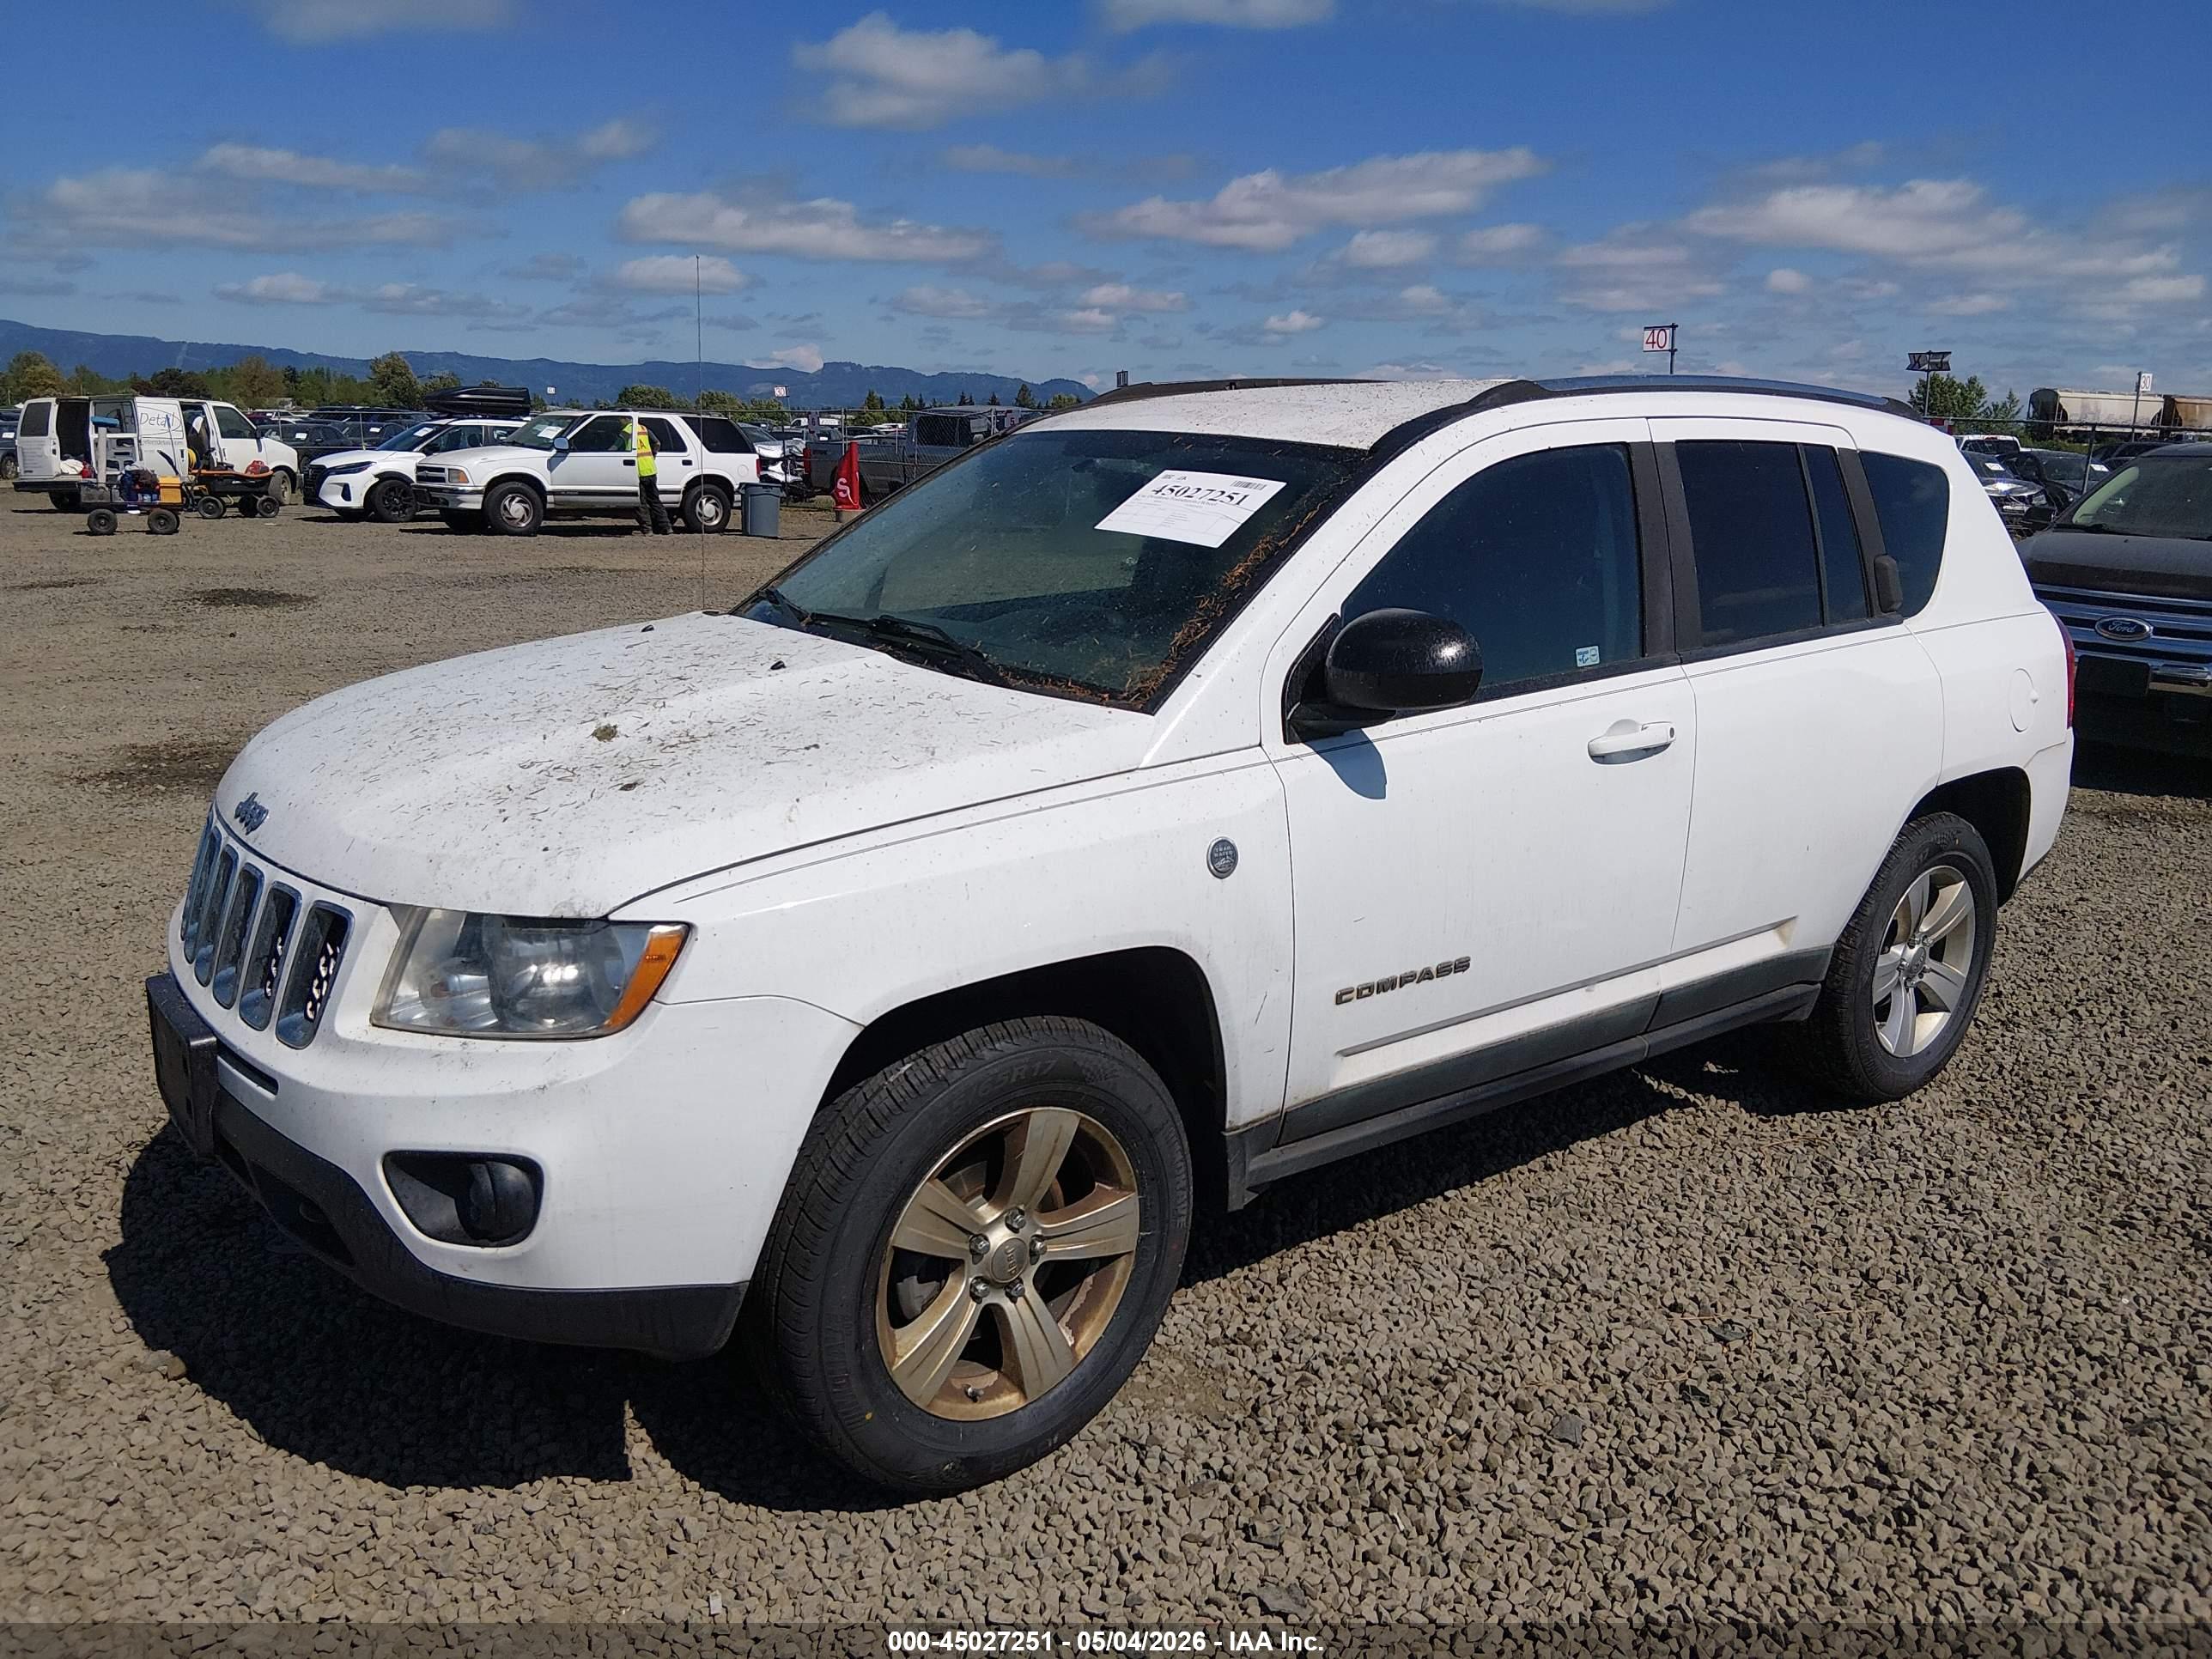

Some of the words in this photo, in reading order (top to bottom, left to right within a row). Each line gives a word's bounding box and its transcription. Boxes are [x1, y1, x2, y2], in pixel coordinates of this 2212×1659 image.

[1645, 329, 1668, 349] 40
[2140, 374, 2151, 390] 30
[140, 412, 175, 428] Detal
[1152, 483, 1251, 507] 45027251
[2108, 620, 2137, 634] Ford
[1335, 956, 1472, 1006] COMPASS
